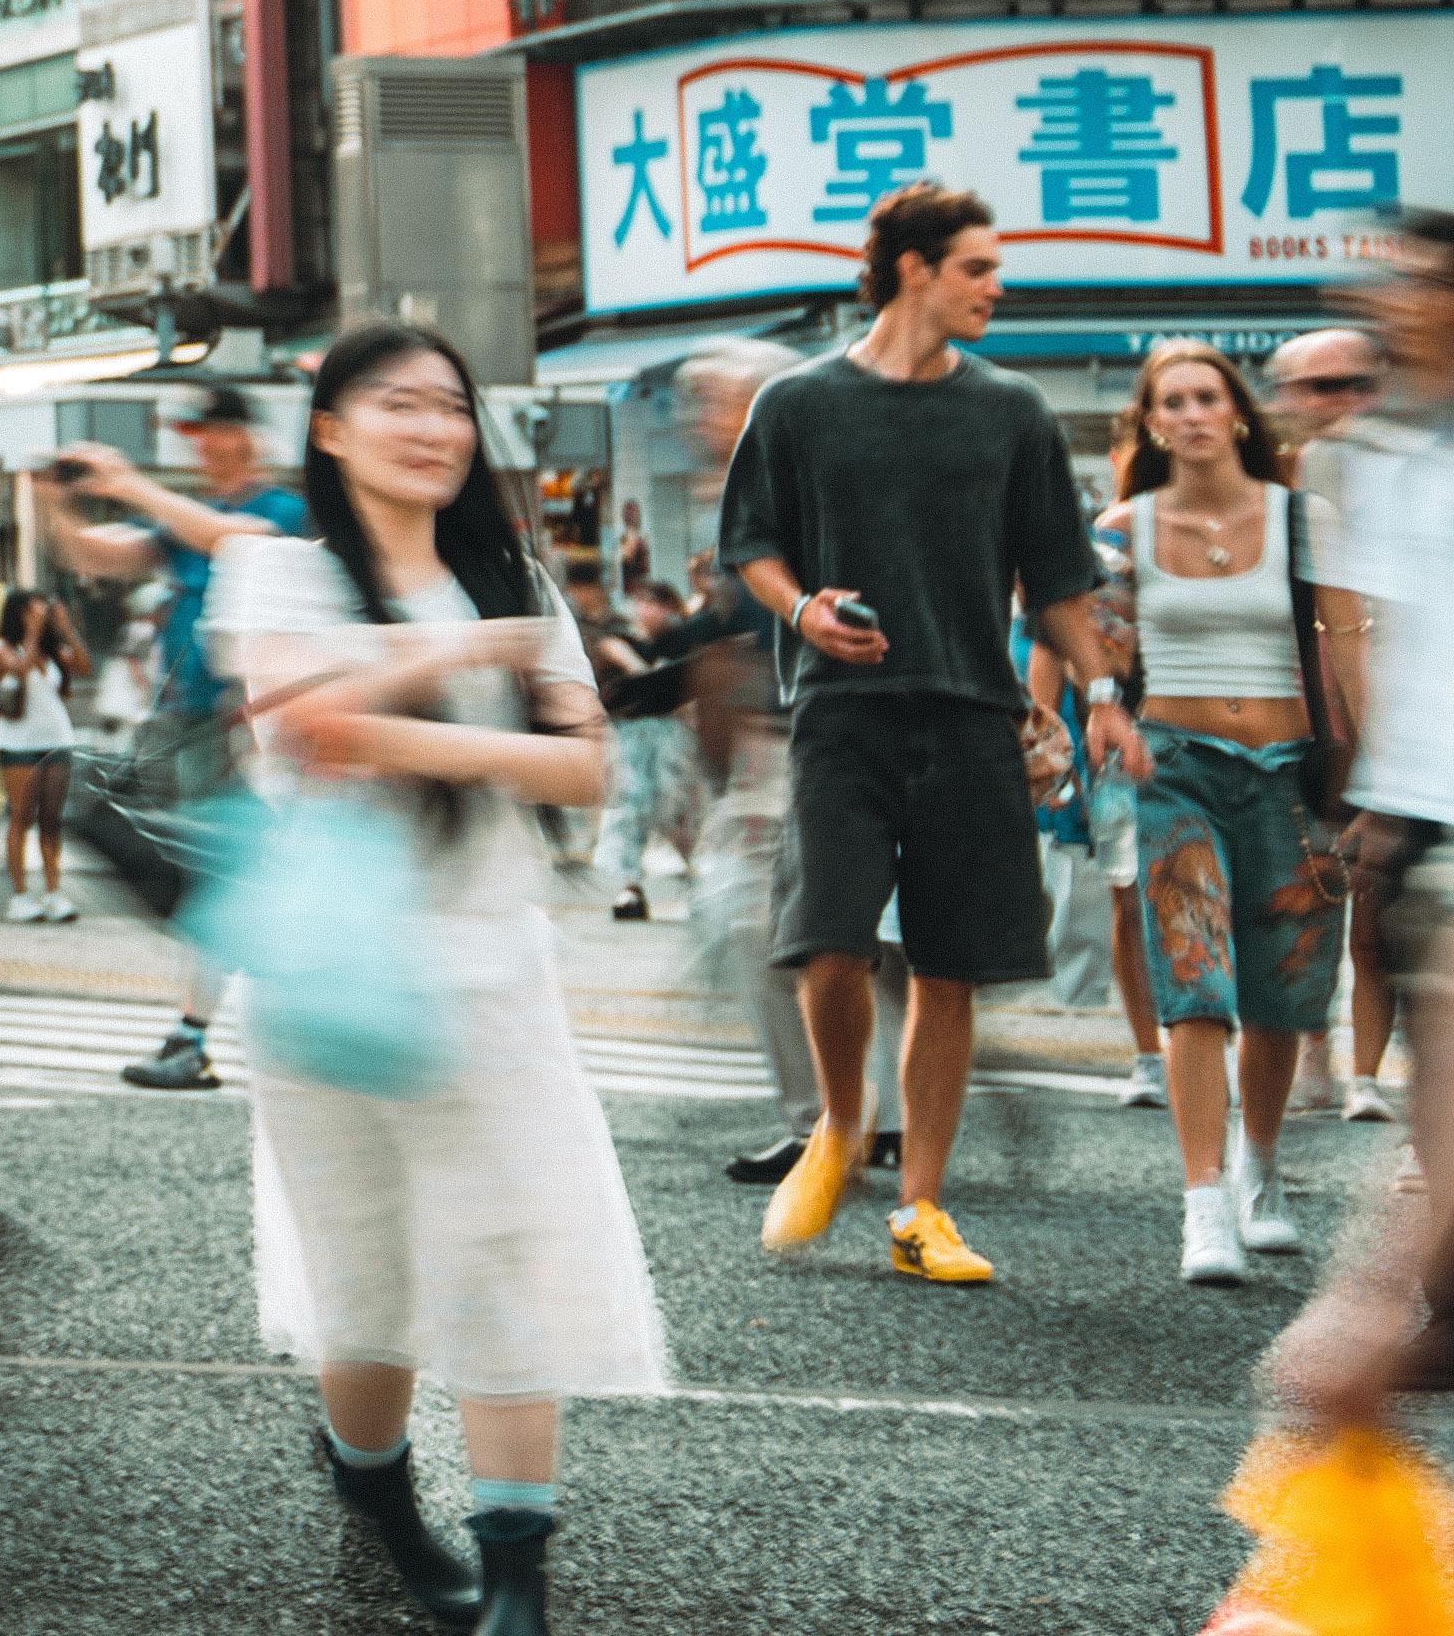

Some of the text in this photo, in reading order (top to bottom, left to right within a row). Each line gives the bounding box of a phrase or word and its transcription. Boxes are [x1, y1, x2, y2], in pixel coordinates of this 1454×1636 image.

[612, 64, 1404, 248] 大盛堂書店
[1248, 236, 1330, 261] BOOKS
